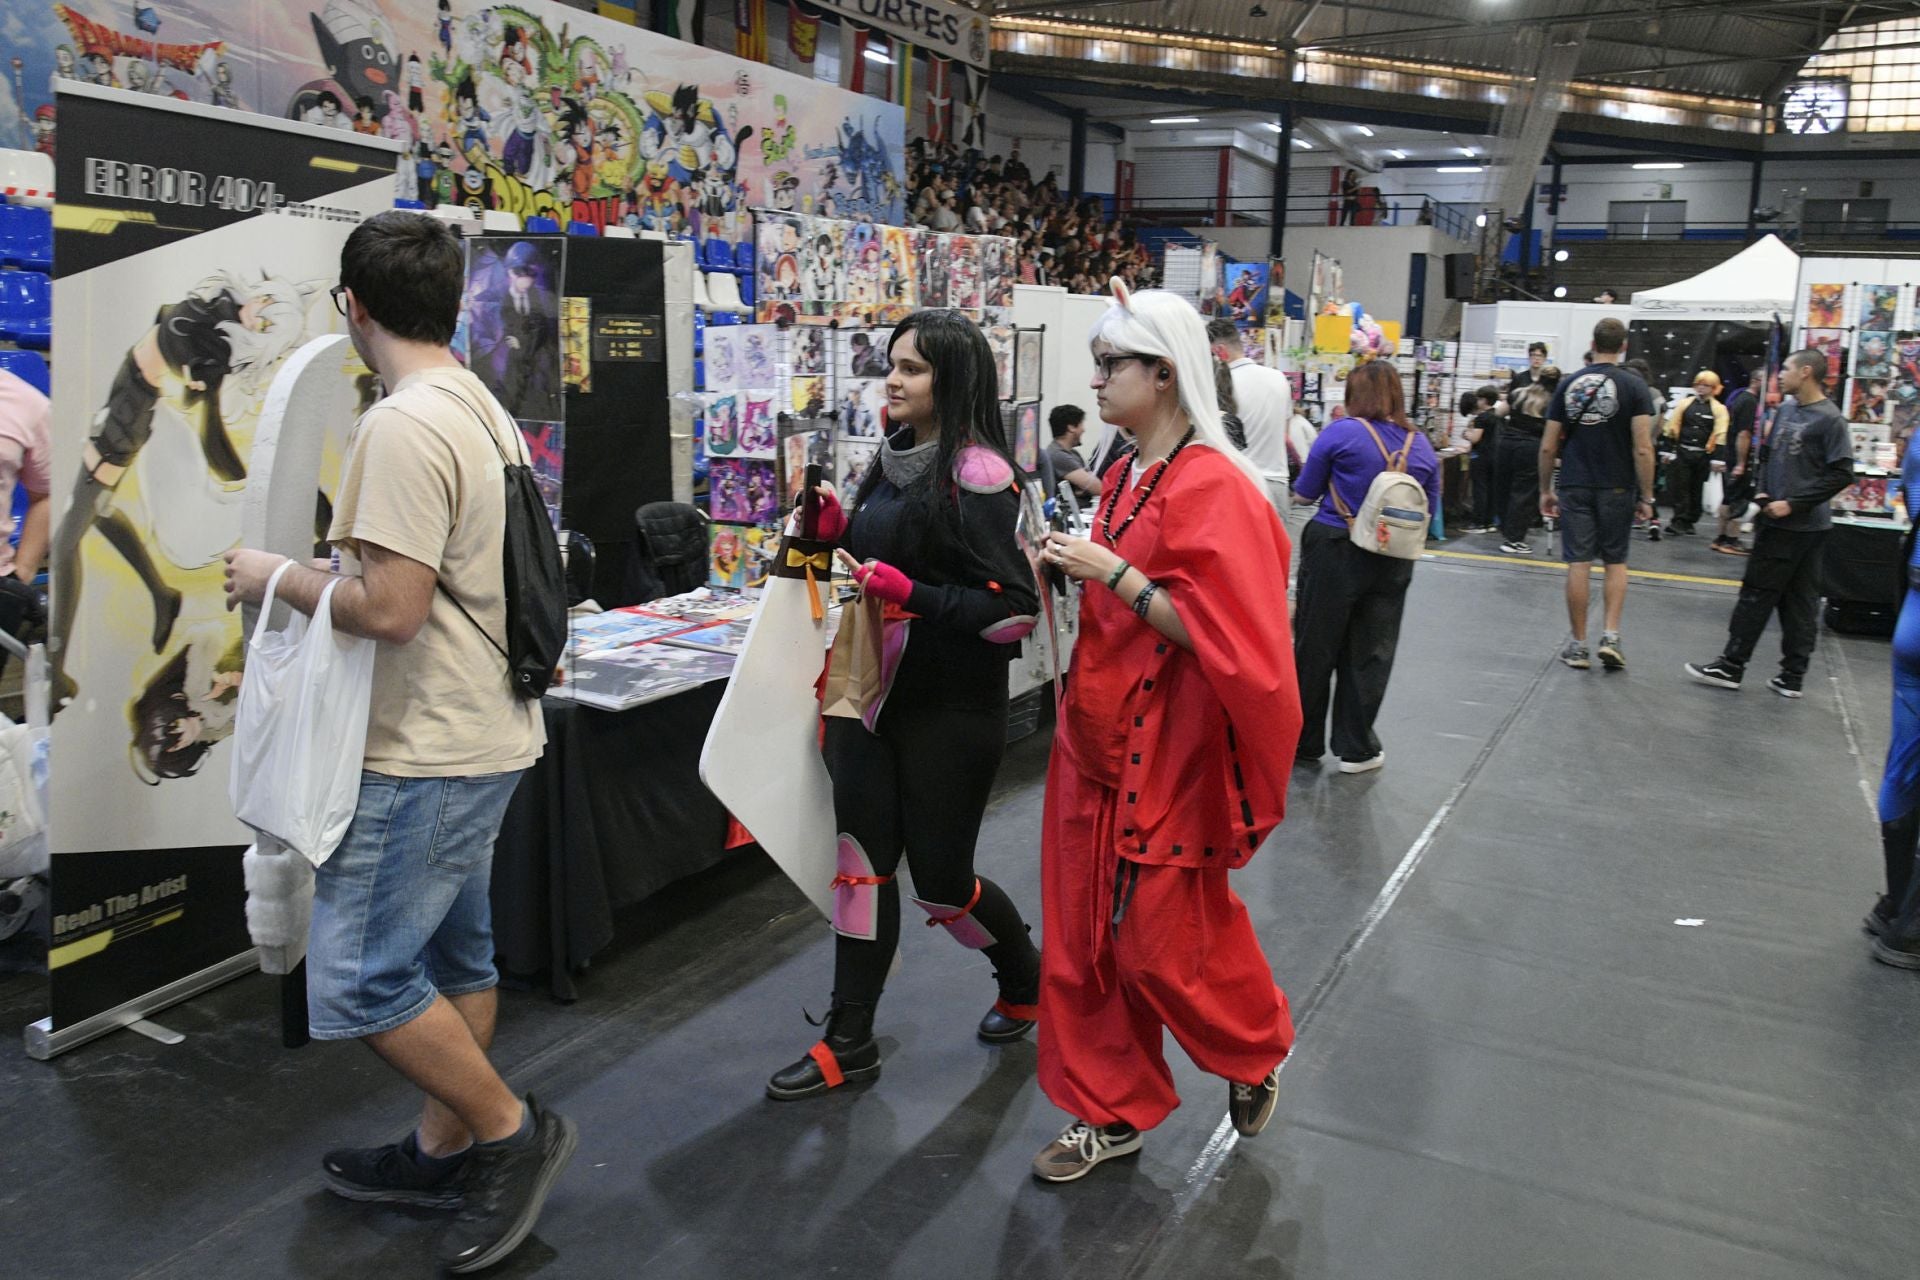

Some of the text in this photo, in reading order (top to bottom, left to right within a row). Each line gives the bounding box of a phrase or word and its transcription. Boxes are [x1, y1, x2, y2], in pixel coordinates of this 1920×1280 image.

[85, 157, 206, 207] ERROR
[104, 893, 138, 917] The
[140, 874, 187, 906] Artist
